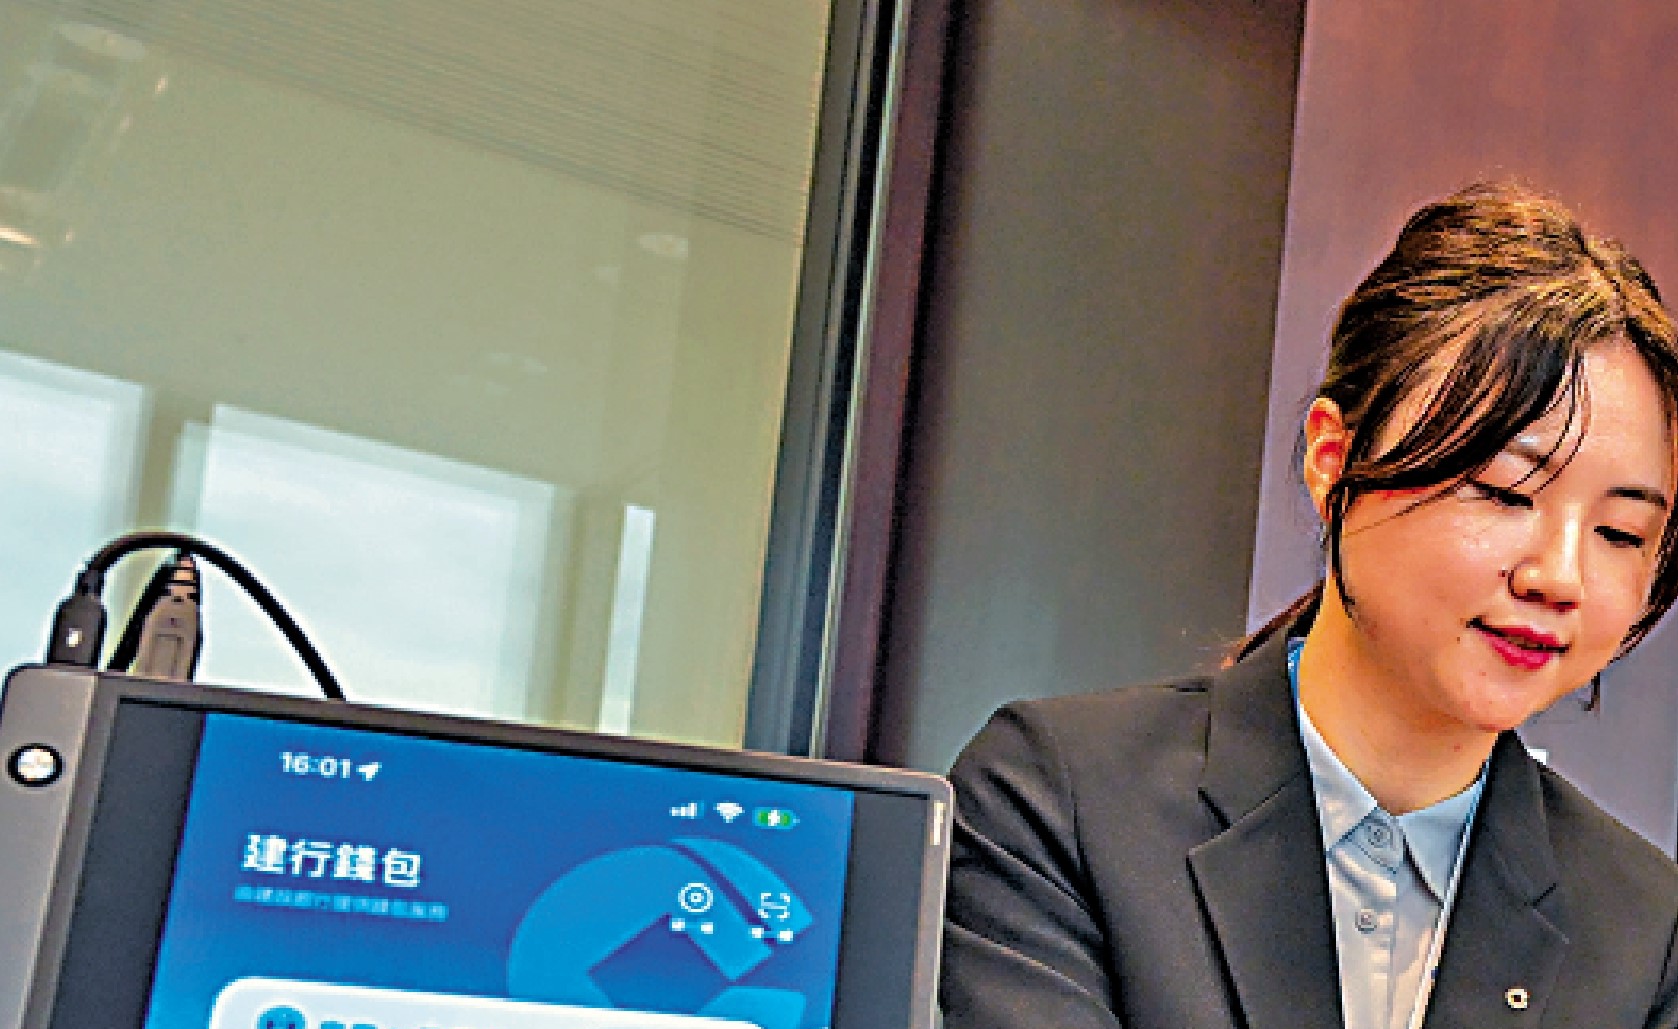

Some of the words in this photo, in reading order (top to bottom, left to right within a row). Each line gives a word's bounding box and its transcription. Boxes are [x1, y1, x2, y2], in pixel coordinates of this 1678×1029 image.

[280, 751, 351, 779] 16:01
[241, 832, 421, 888] 建行錢包
